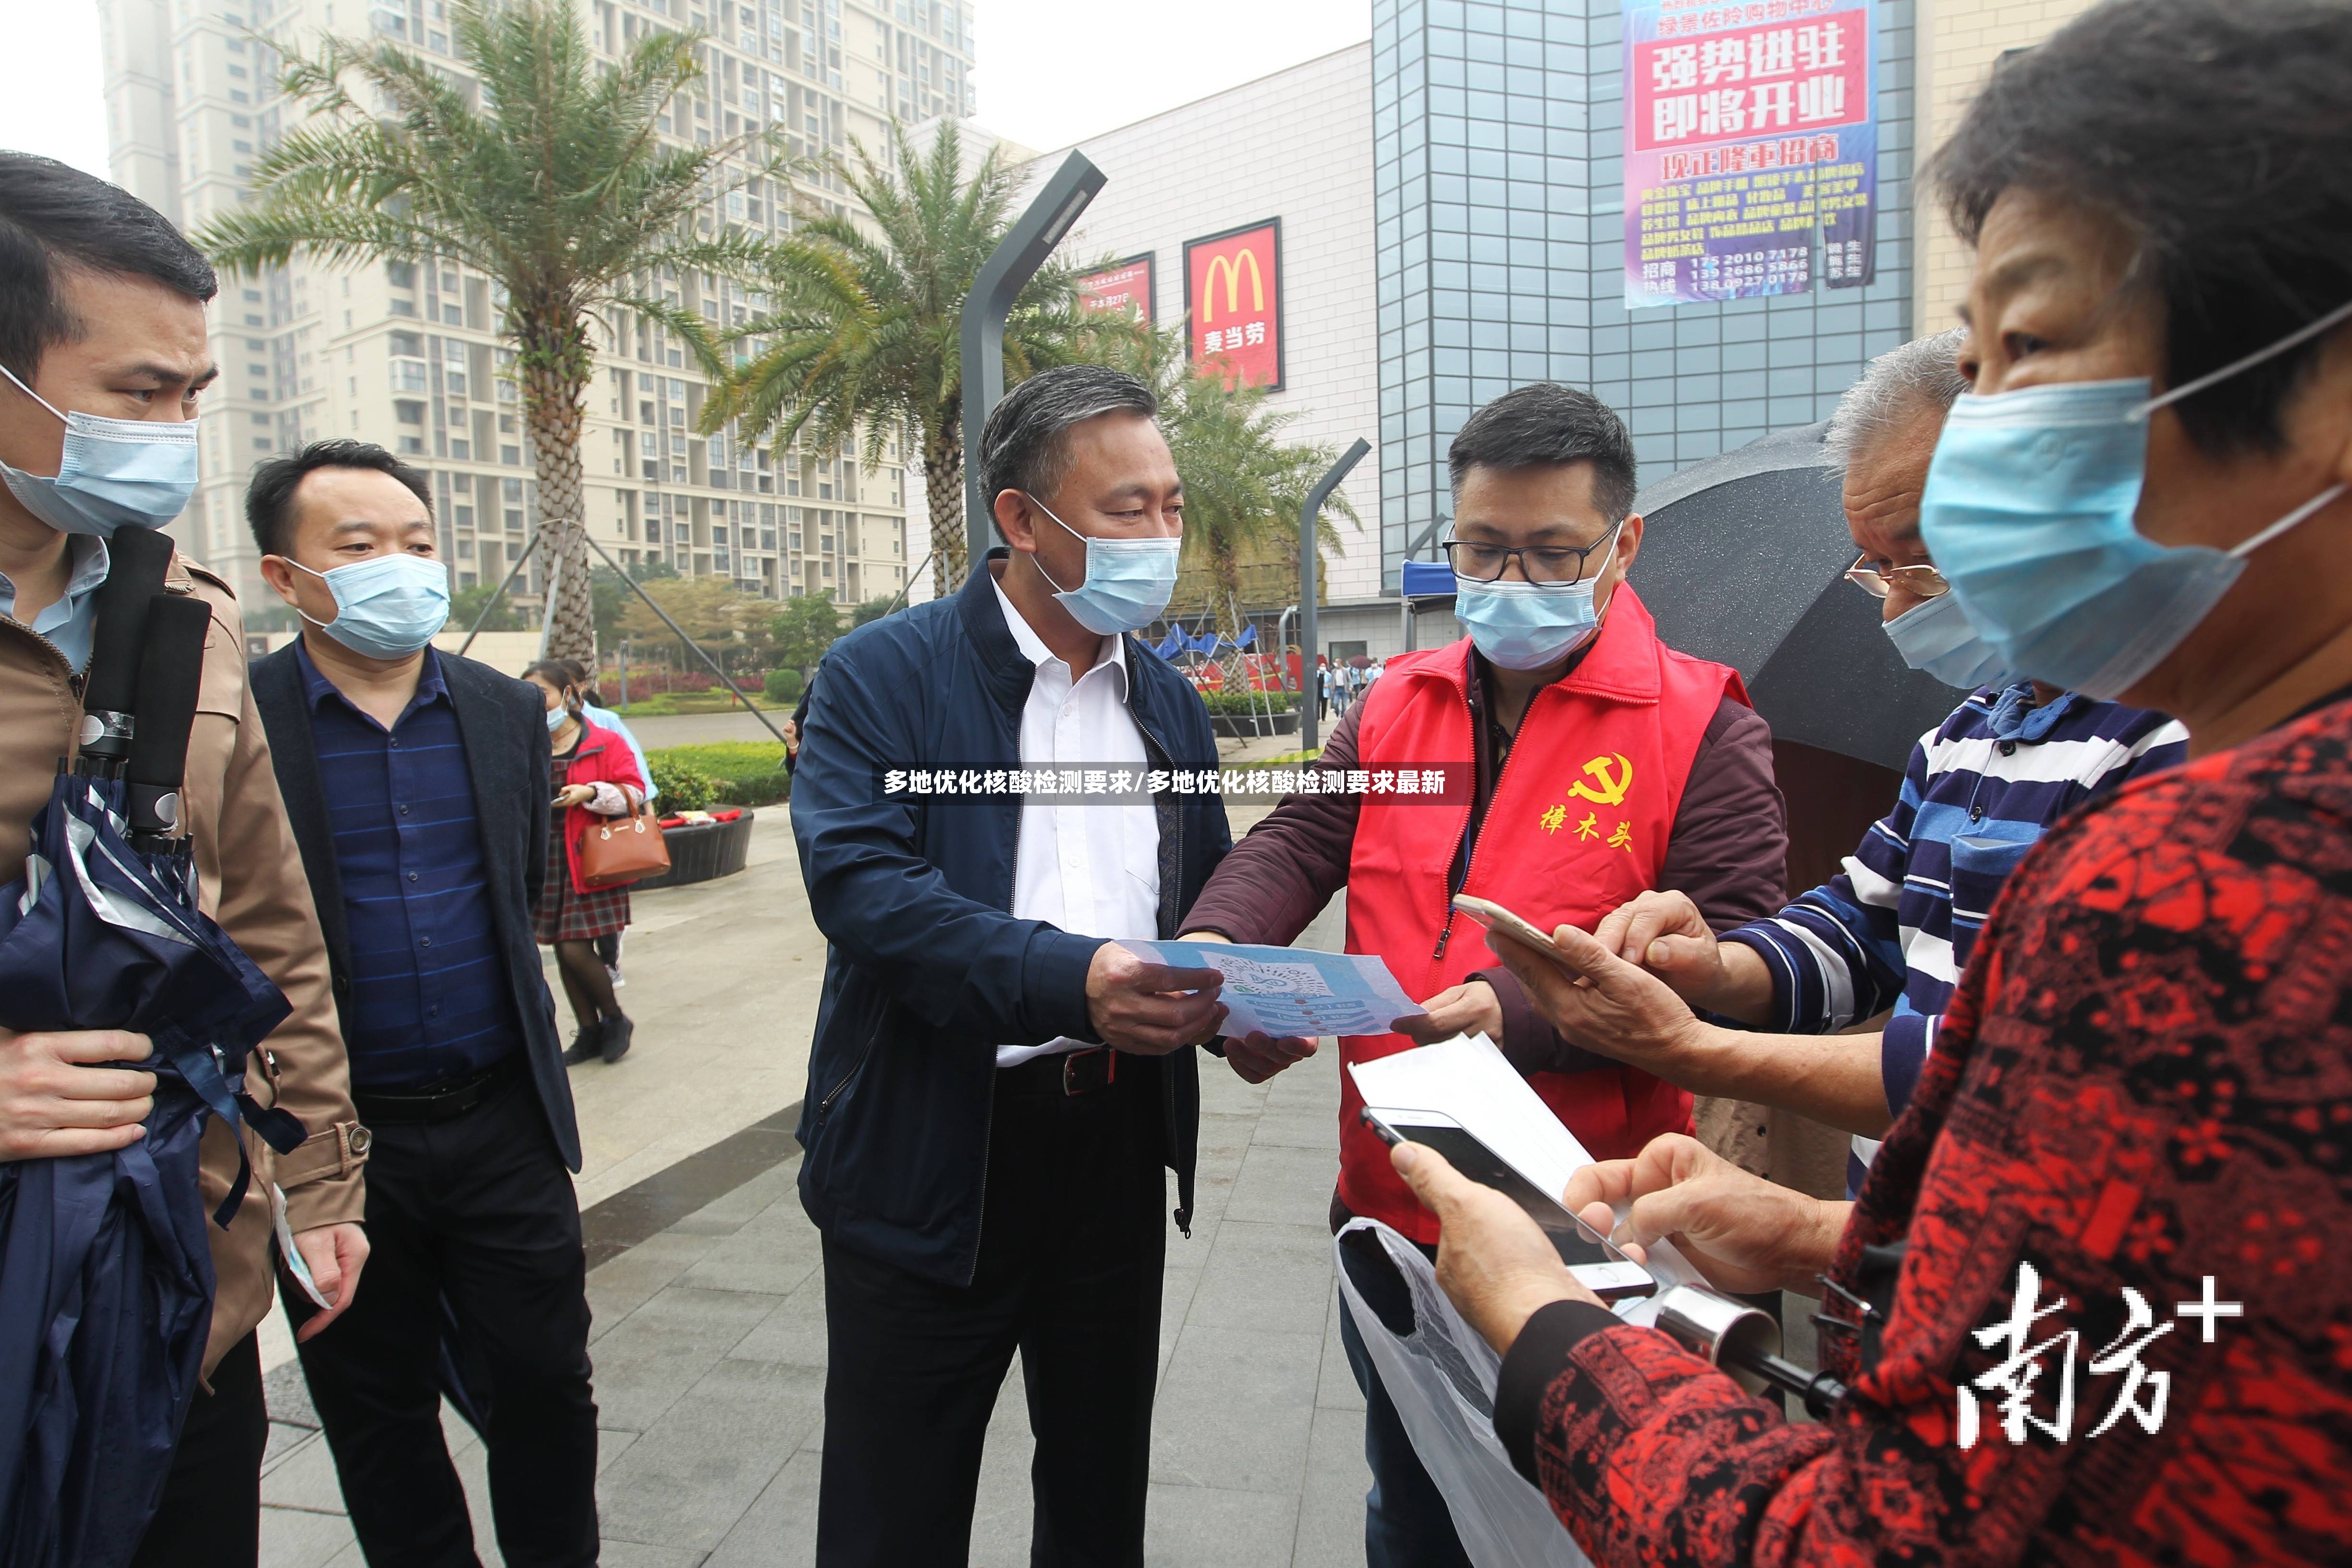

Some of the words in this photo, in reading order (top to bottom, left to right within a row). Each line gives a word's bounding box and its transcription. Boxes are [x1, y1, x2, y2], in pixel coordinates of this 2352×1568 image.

[1652, 21, 1846, 93] 强势进驻
[1653, 74, 1846, 142] 即将开业
[1661, 134, 1838, 182] 现正隆重招商
[1642, 261, 1676, 280] 招商
[1690, 256, 1720, 269] 175
[1723, 251, 1764, 266] 2010
[1767, 246, 1808, 260] 7178
[1690, 268, 1720, 281] 139
[1723, 263, 1764, 278] 2686
[1767, 258, 1808, 273] 5866
[1643, 279, 1677, 295] 热线
[1690, 279, 1720, 292] 138
[1724, 276, 1764, 290] 0927
[1768, 271, 1808, 285] 0178
[1204, 321, 1265, 355] 麦当劳
[1540, 804, 1632, 853] 樟木头
